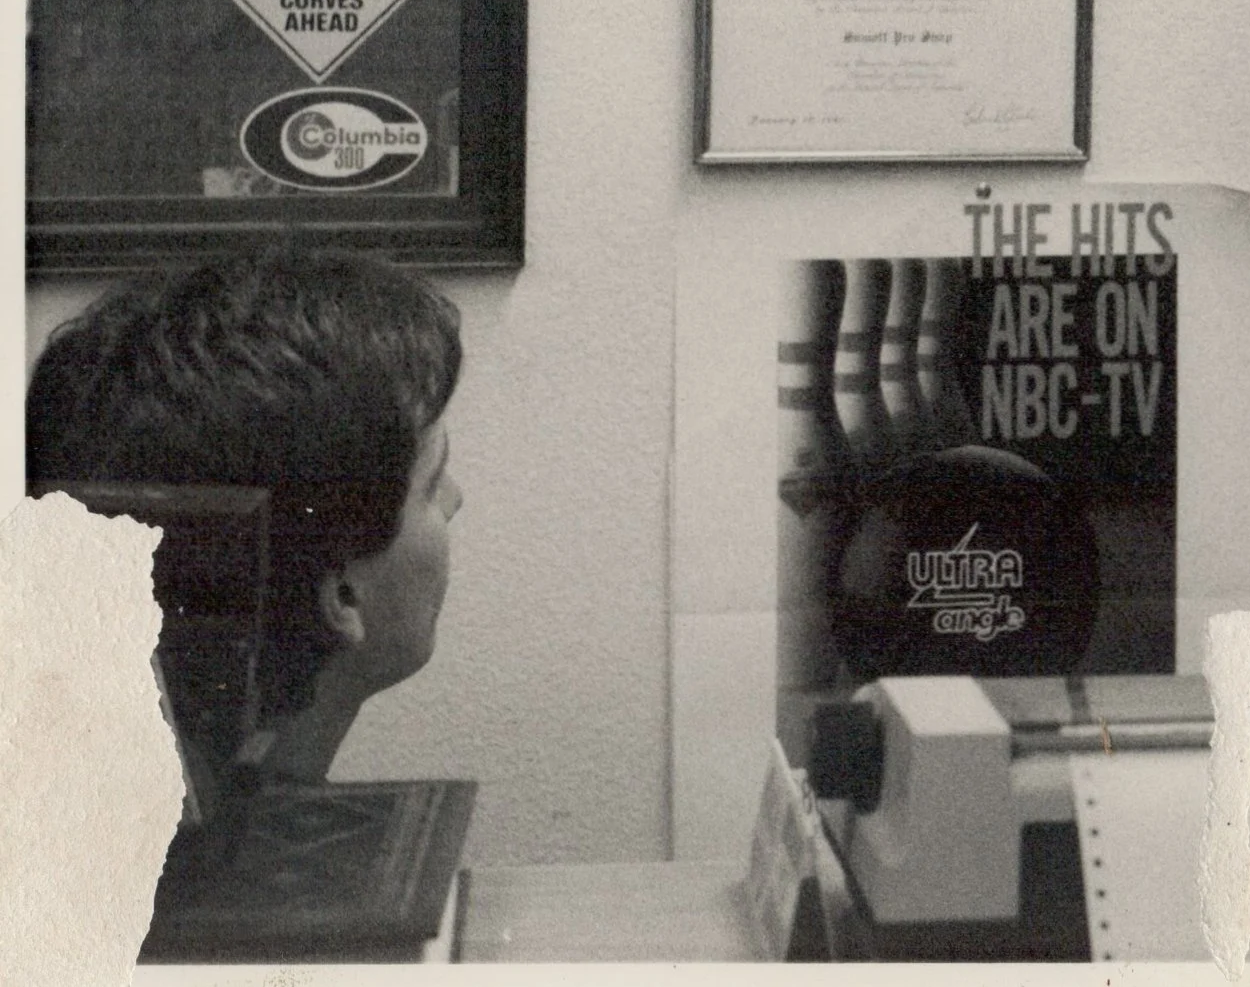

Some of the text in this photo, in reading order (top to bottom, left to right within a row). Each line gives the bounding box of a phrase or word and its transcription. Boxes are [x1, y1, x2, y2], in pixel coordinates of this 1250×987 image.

[284, 12, 358, 33] AHEAD
[301, 127, 421, 146] Columbia
[334, 147, 365, 170] 300
[964, 203, 1174, 278] THE HITS
[986, 281, 1159, 359] ARE ON
[981, 362, 1161, 440] NBC-TV
[907, 534, 1023, 589] ULTRA
[933, 594, 1025, 641] angle
